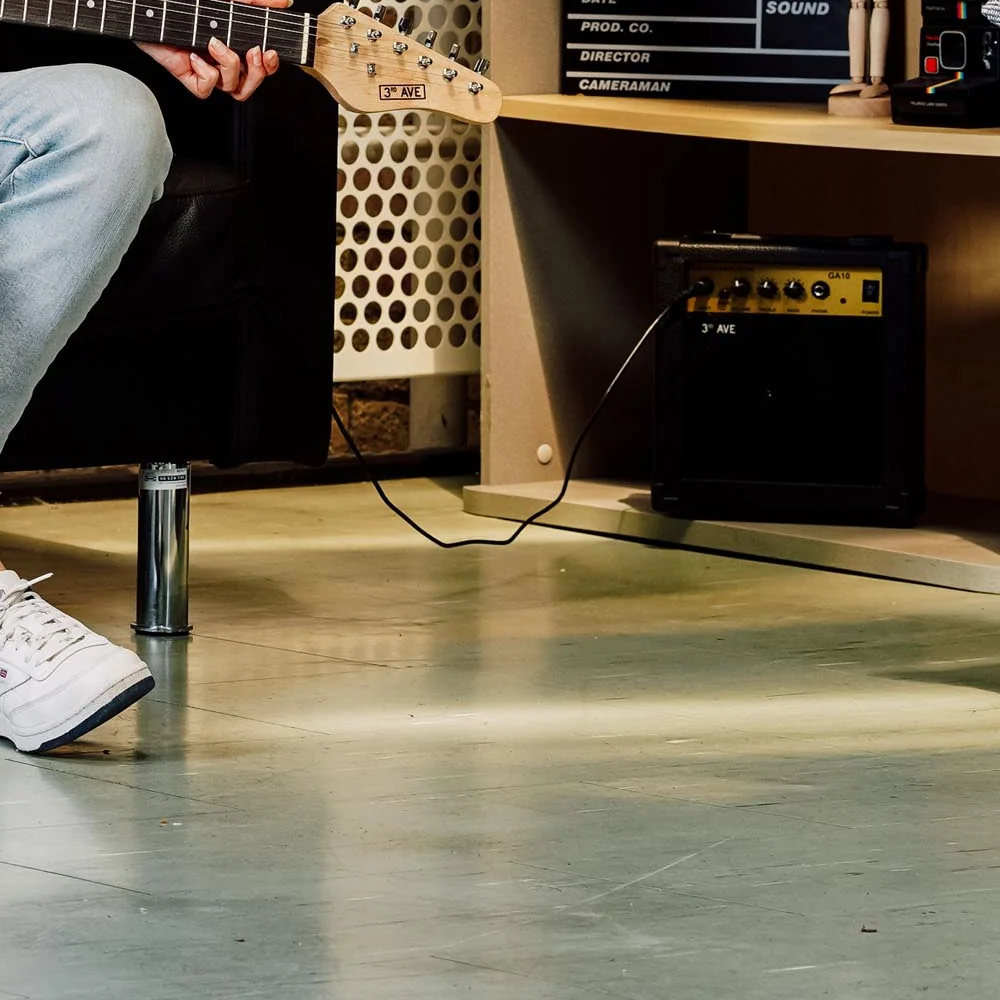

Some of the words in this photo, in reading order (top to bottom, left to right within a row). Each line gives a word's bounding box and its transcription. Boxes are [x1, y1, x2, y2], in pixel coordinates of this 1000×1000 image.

[765, 1, 830, 15] SOUND
[580, 21, 624, 32] PROD.
[628, 22, 653, 33] CO.
[580, 50, 651, 63] DIRECTOR
[578, 78, 671, 93] CAMERAMAN
[400, 86, 422, 98] AVE
[828, 271, 850, 280] GA10
[716, 324, 736, 335] AVE
